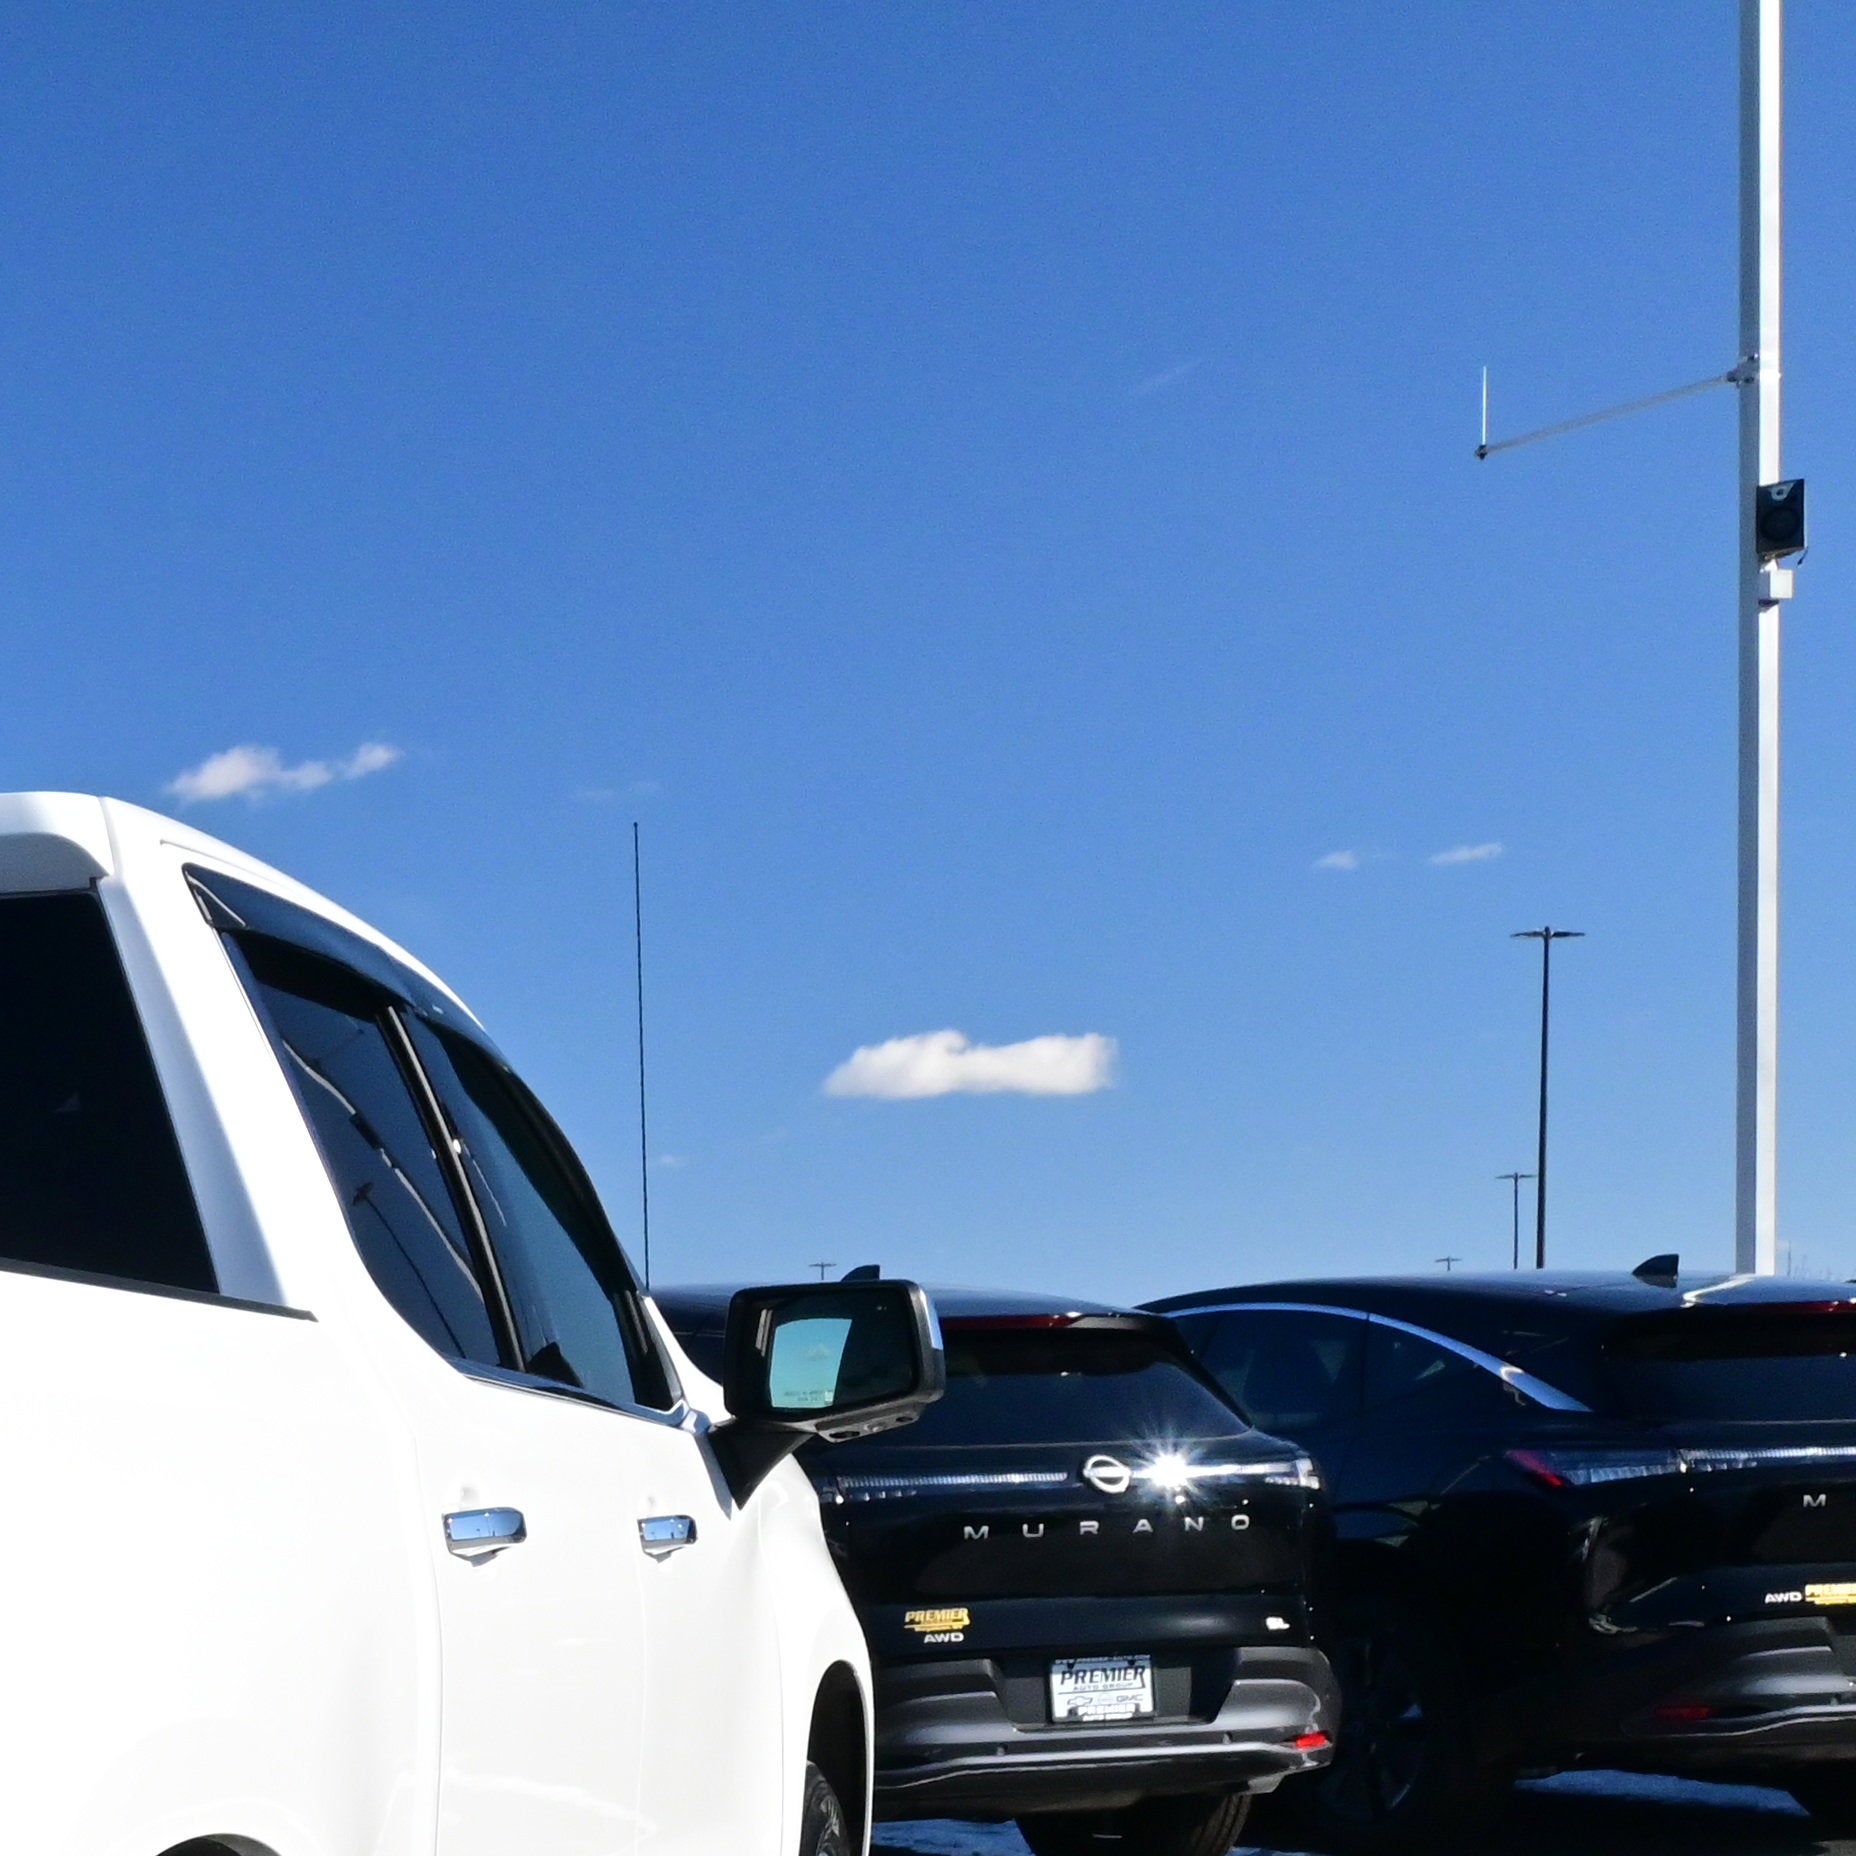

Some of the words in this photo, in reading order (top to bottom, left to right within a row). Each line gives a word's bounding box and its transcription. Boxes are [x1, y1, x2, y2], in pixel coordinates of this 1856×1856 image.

[963, 1514, 1250, 1540] MURANO
[1765, 1591, 1803, 1604] AWD
[904, 1607, 970, 1622] PREMIER
[923, 1632, 965, 1643] AWD
[1060, 1665, 1145, 1686] PREMIER
